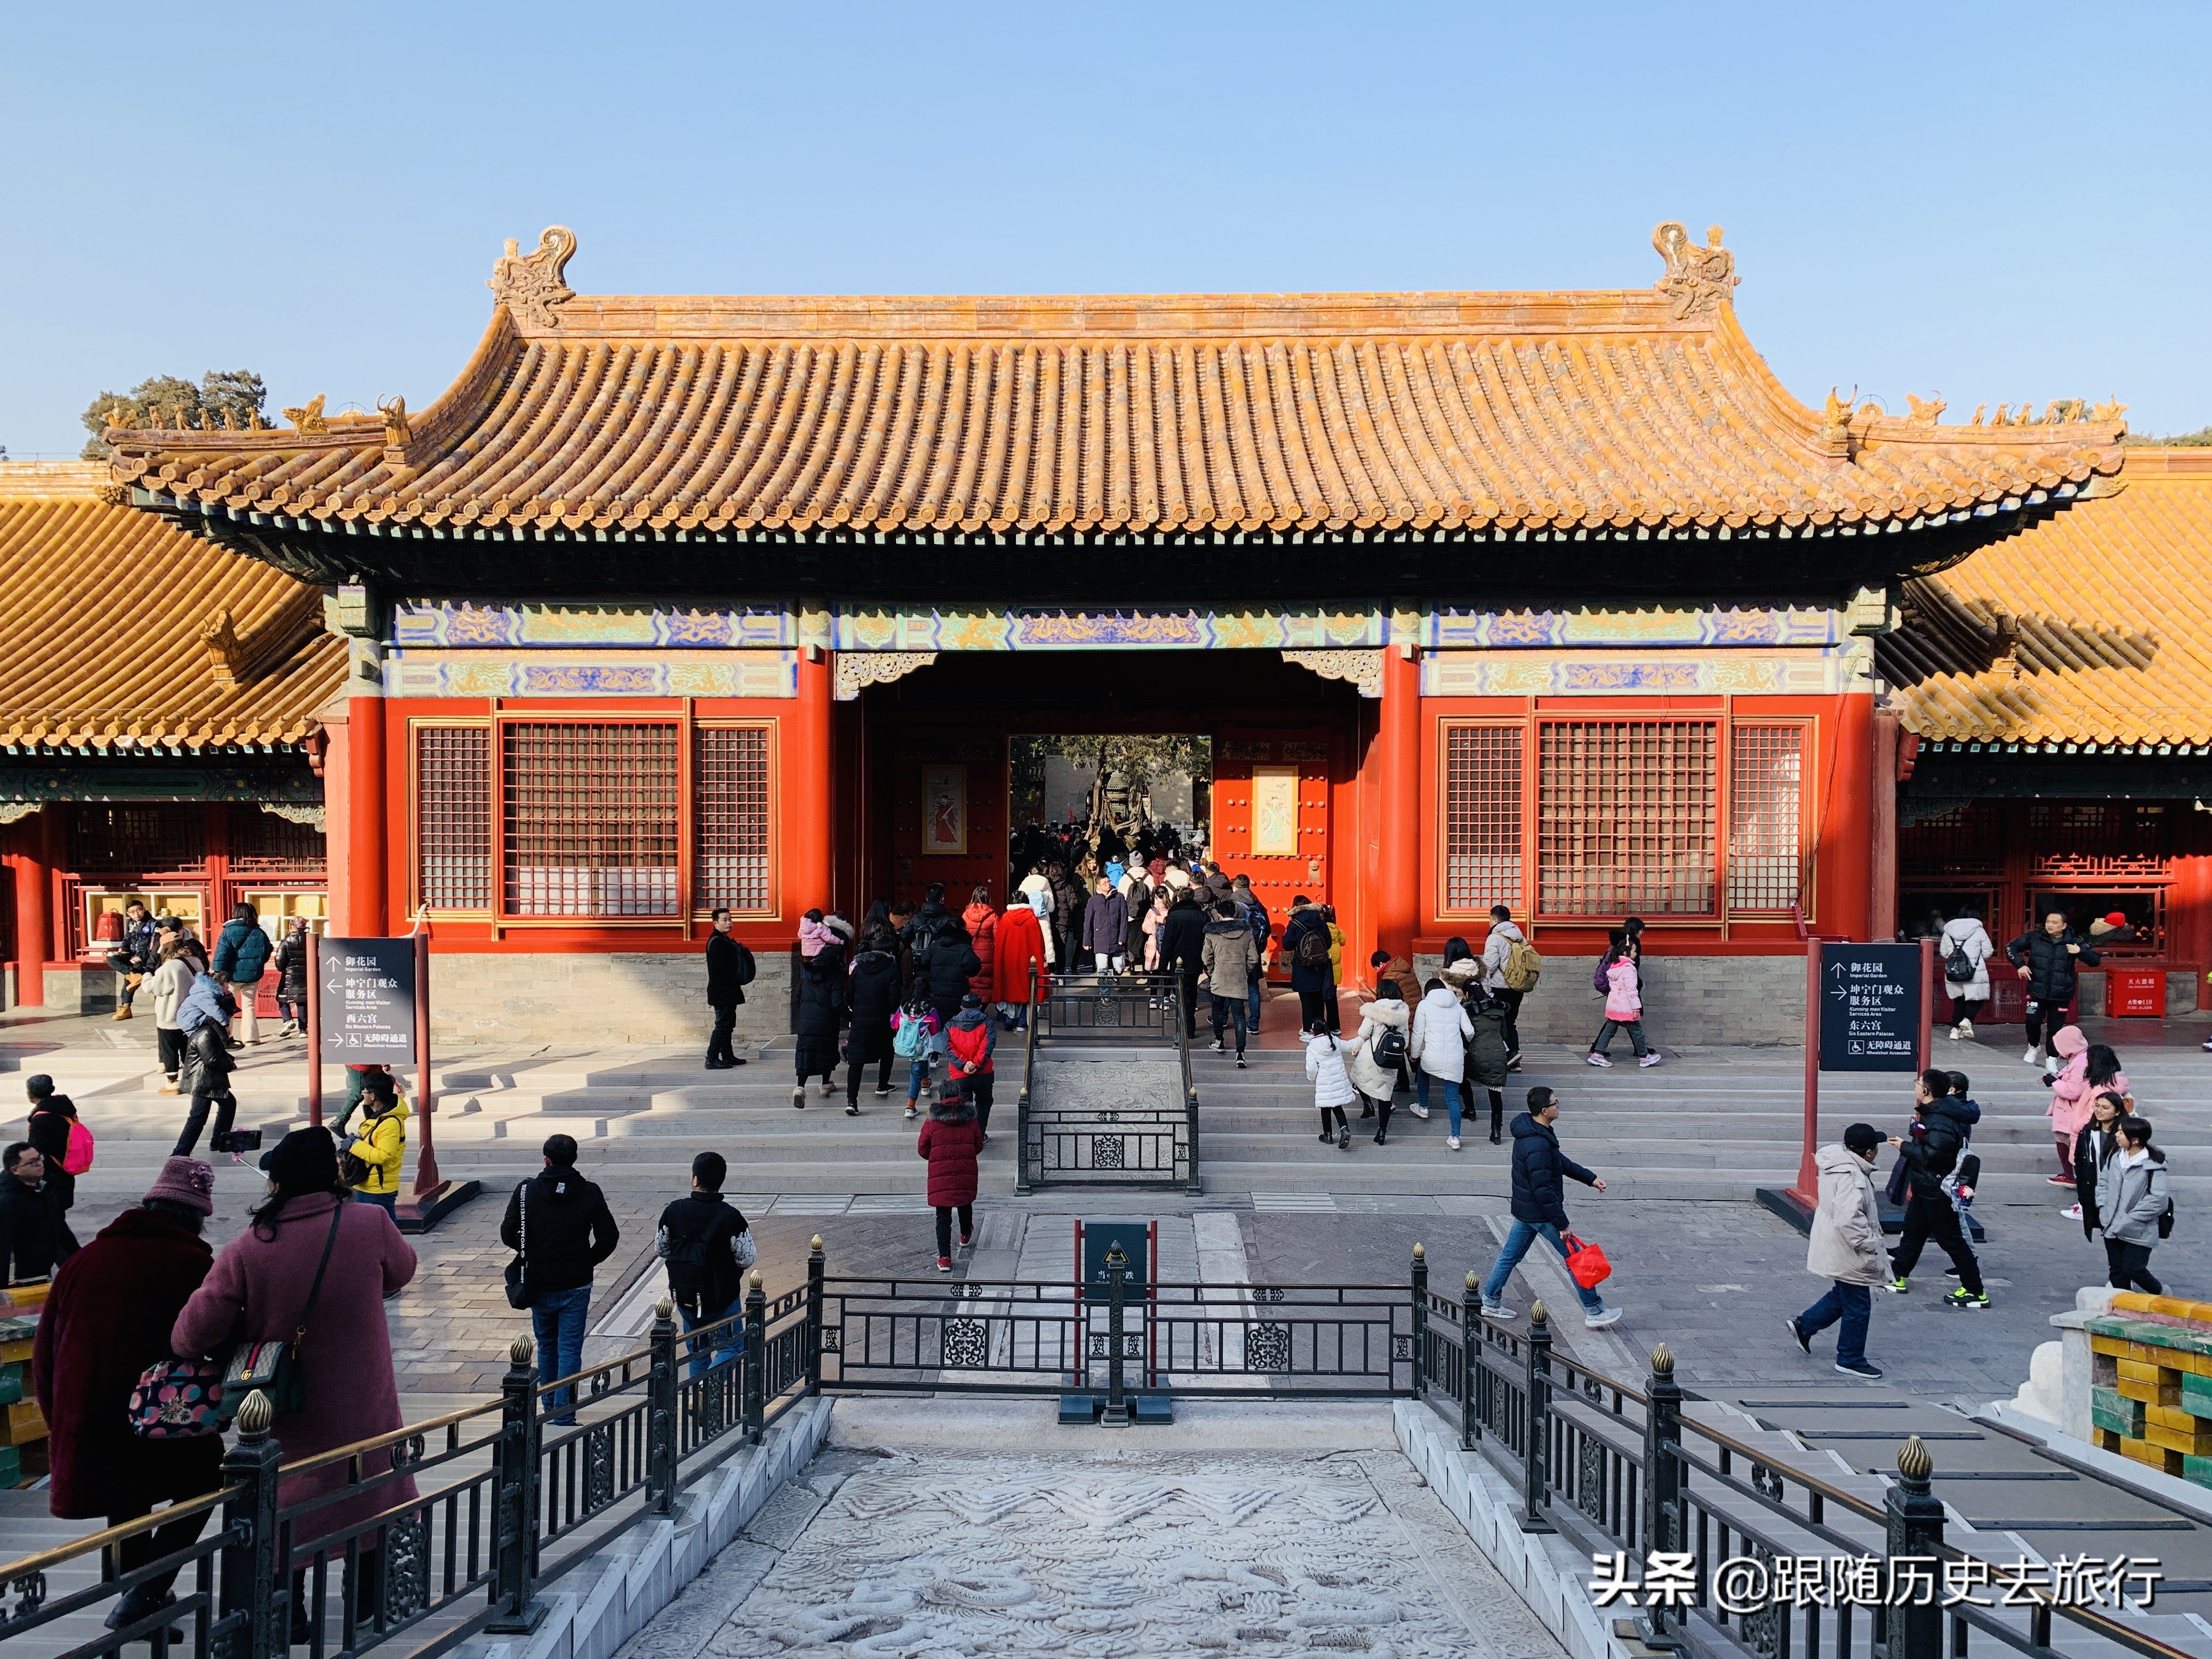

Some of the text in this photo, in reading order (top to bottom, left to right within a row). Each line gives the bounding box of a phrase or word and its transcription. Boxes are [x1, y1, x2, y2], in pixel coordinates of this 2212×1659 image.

[345, 956, 376, 966] 御花园
[1851, 963, 1883, 973] 御花园
[345, 978, 398, 988] 坤宁门观众
[345, 990, 377, 999] 服务区
[1850, 985, 1904, 995] 坤宁门观众
[1849, 996, 1882, 1006] 服务区
[346, 1013, 377, 1023] 西六宫
[1849, 1020, 1881, 1030] 东六宫
[364, 1034, 407, 1043] 无障碍通道
[1866, 1041, 1911, 1050] 无障碍通道
[1098, 1270, 1134, 1279] 当跌
